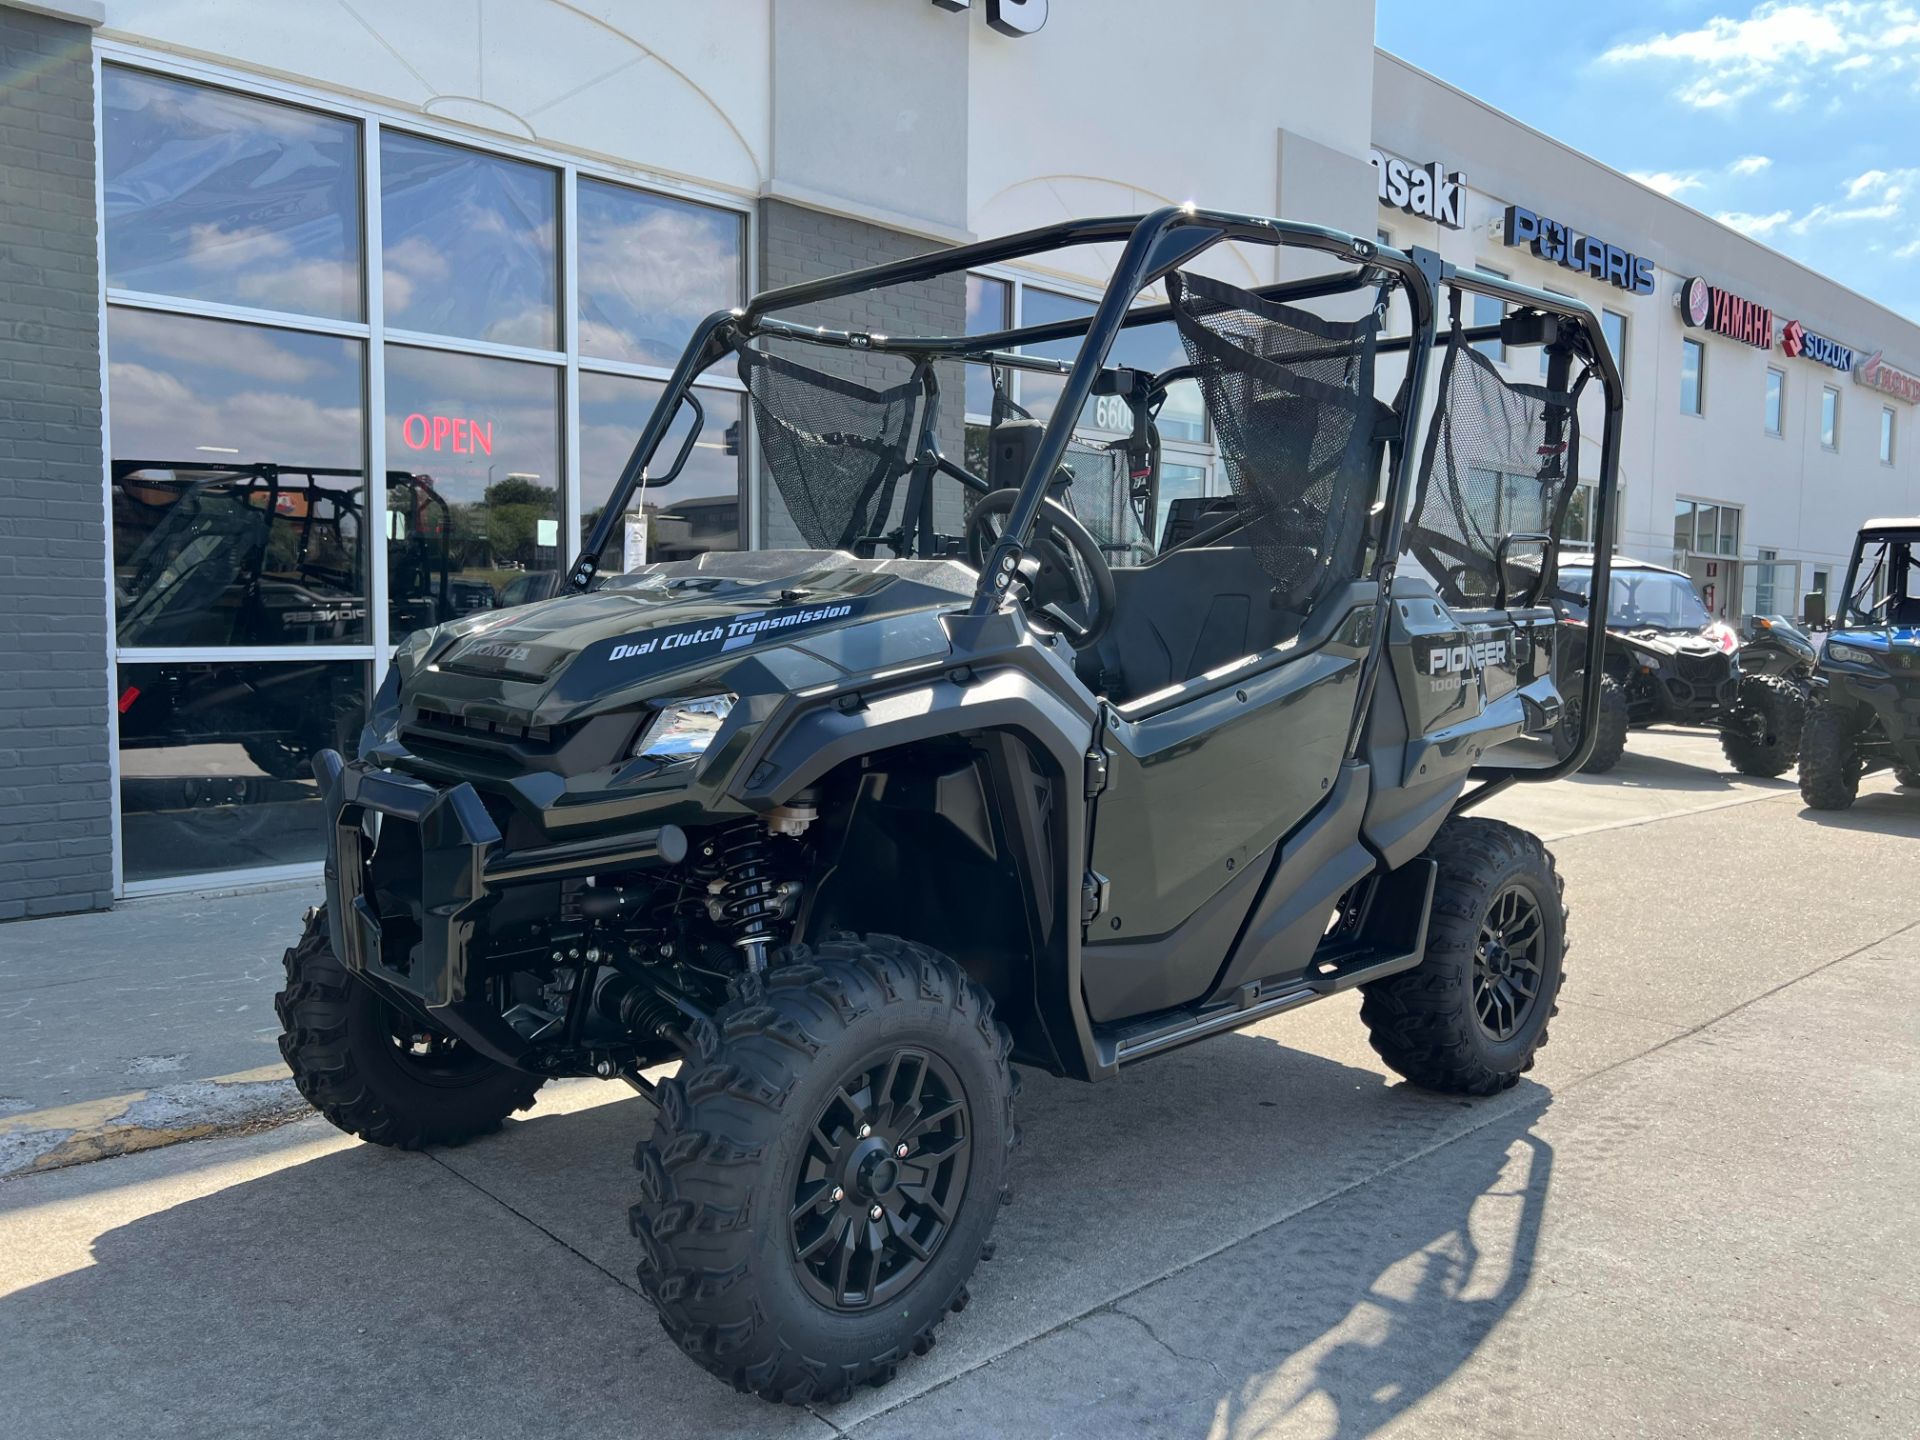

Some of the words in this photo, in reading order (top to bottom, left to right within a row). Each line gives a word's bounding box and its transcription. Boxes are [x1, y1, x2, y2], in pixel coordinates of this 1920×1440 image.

[1508, 206, 1655, 295] POLARIS
[1709, 286, 1773, 350] YAMAHA
[1804, 333, 1854, 371] SUZUKI
[403, 412, 493, 456] OPEN
[609, 638, 658, 661] Dual
[661, 626, 724, 650] Clutch
[727, 605, 851, 637] Transmission
[1430, 640, 1506, 675] PIONEER
[1430, 678, 1461, 693] 1000
